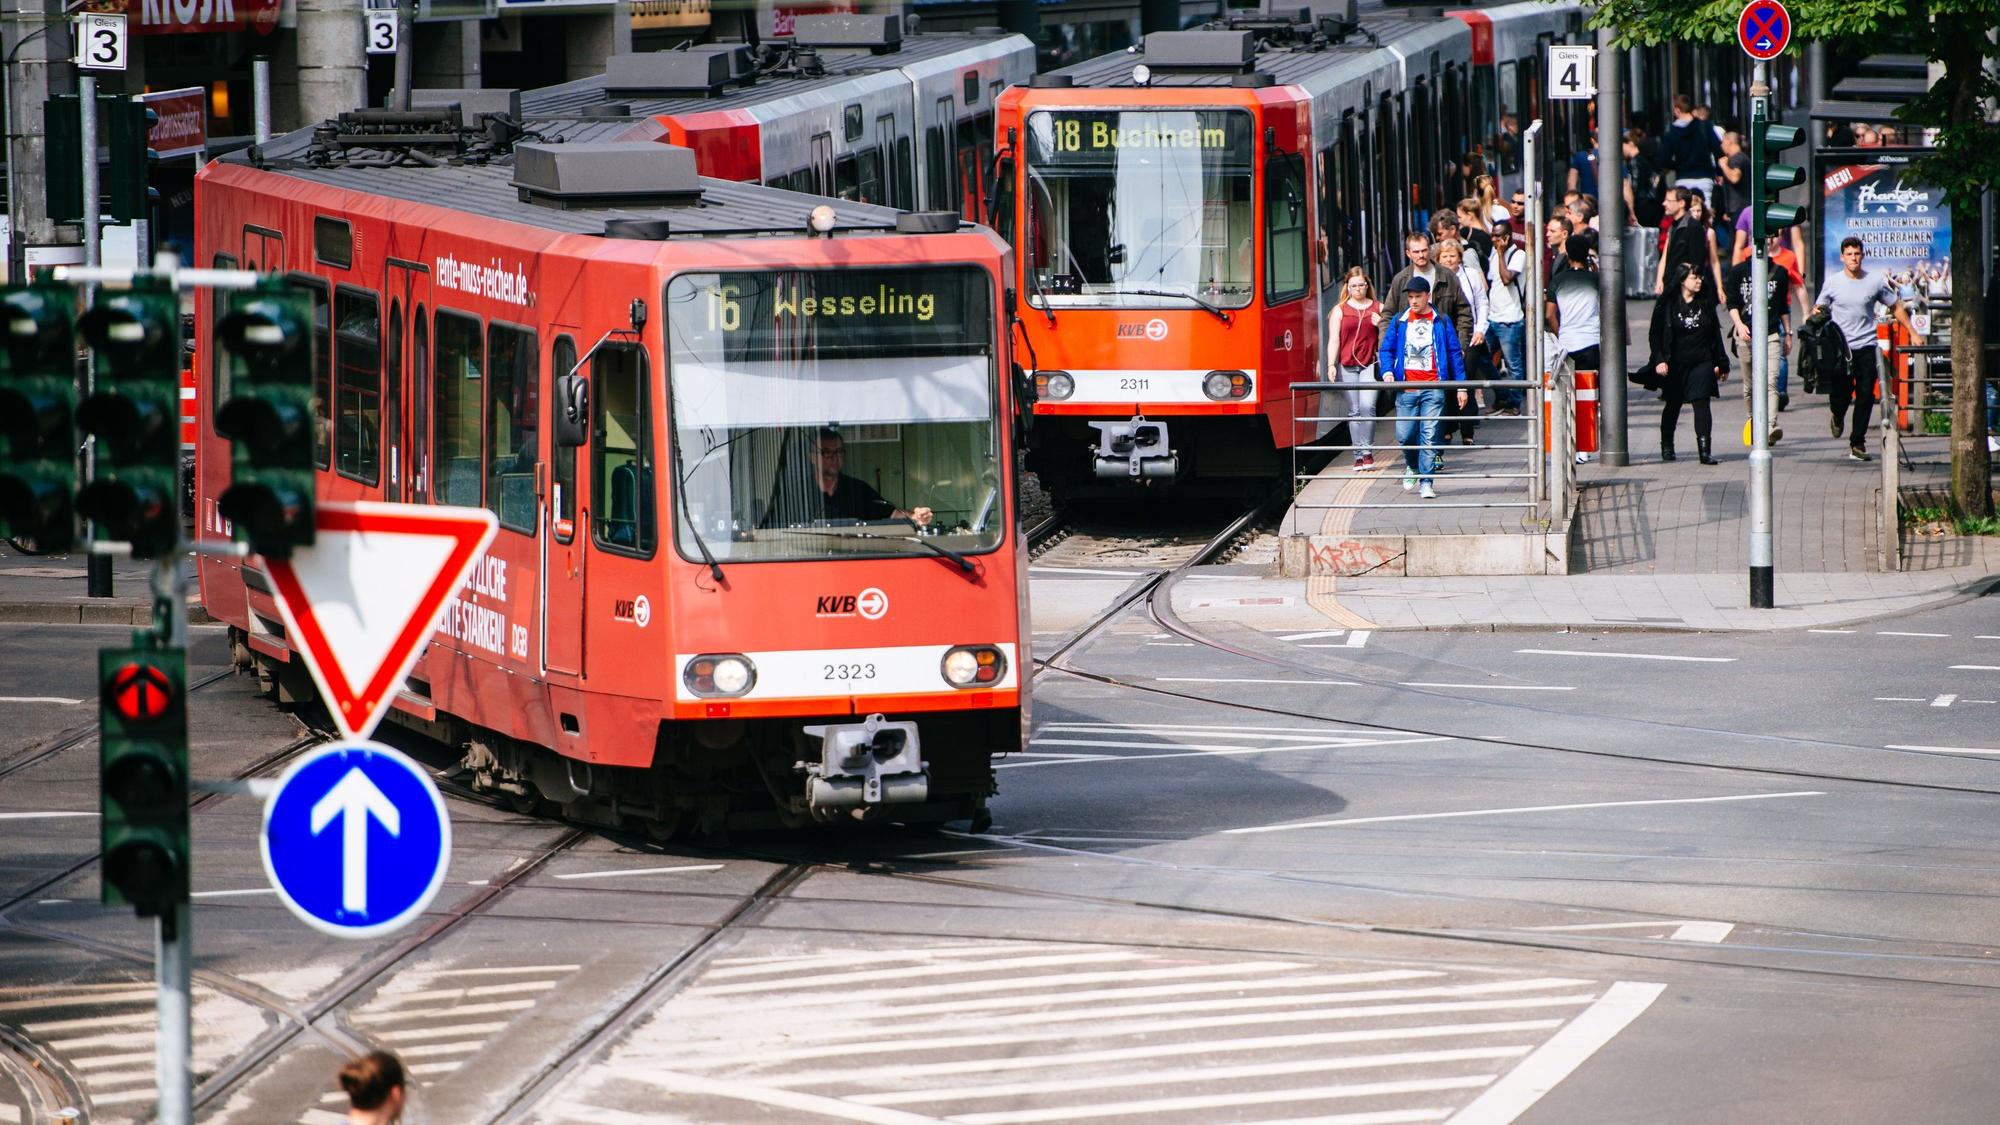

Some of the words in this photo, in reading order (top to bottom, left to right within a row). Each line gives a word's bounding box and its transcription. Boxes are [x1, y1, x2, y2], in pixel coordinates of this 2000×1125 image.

[94, 17, 117, 27] Gleis
[92, 29, 118, 63] 3
[375, 23, 394, 49] 3
[1558, 51, 1579, 60] Gleis
[1560, 63, 1580, 92] 4
[1055, 120, 1080, 151] 18
[1092, 121, 1225, 148] Buchheim
[1825, 168, 1853, 190] NEU!
[1861, 232, 1932, 243] ACHTERBAHNEN
[1865, 247, 1929, 257] WELTREKORDE
[436, 252, 527, 306] rente-muss-reichen.de
[705, 284, 741, 331] 16
[774, 284, 935, 320] Wesseling
[1118, 322, 1144, 336] KVB
[1120, 379, 1150, 390] 2311
[615, 599, 634, 618] KVB
[816, 595, 857, 613] KVB
[462, 594, 505, 656] STÄRKEN!
[512, 623, 528, 658] DGB
[823, 663, 876, 680] 2323
